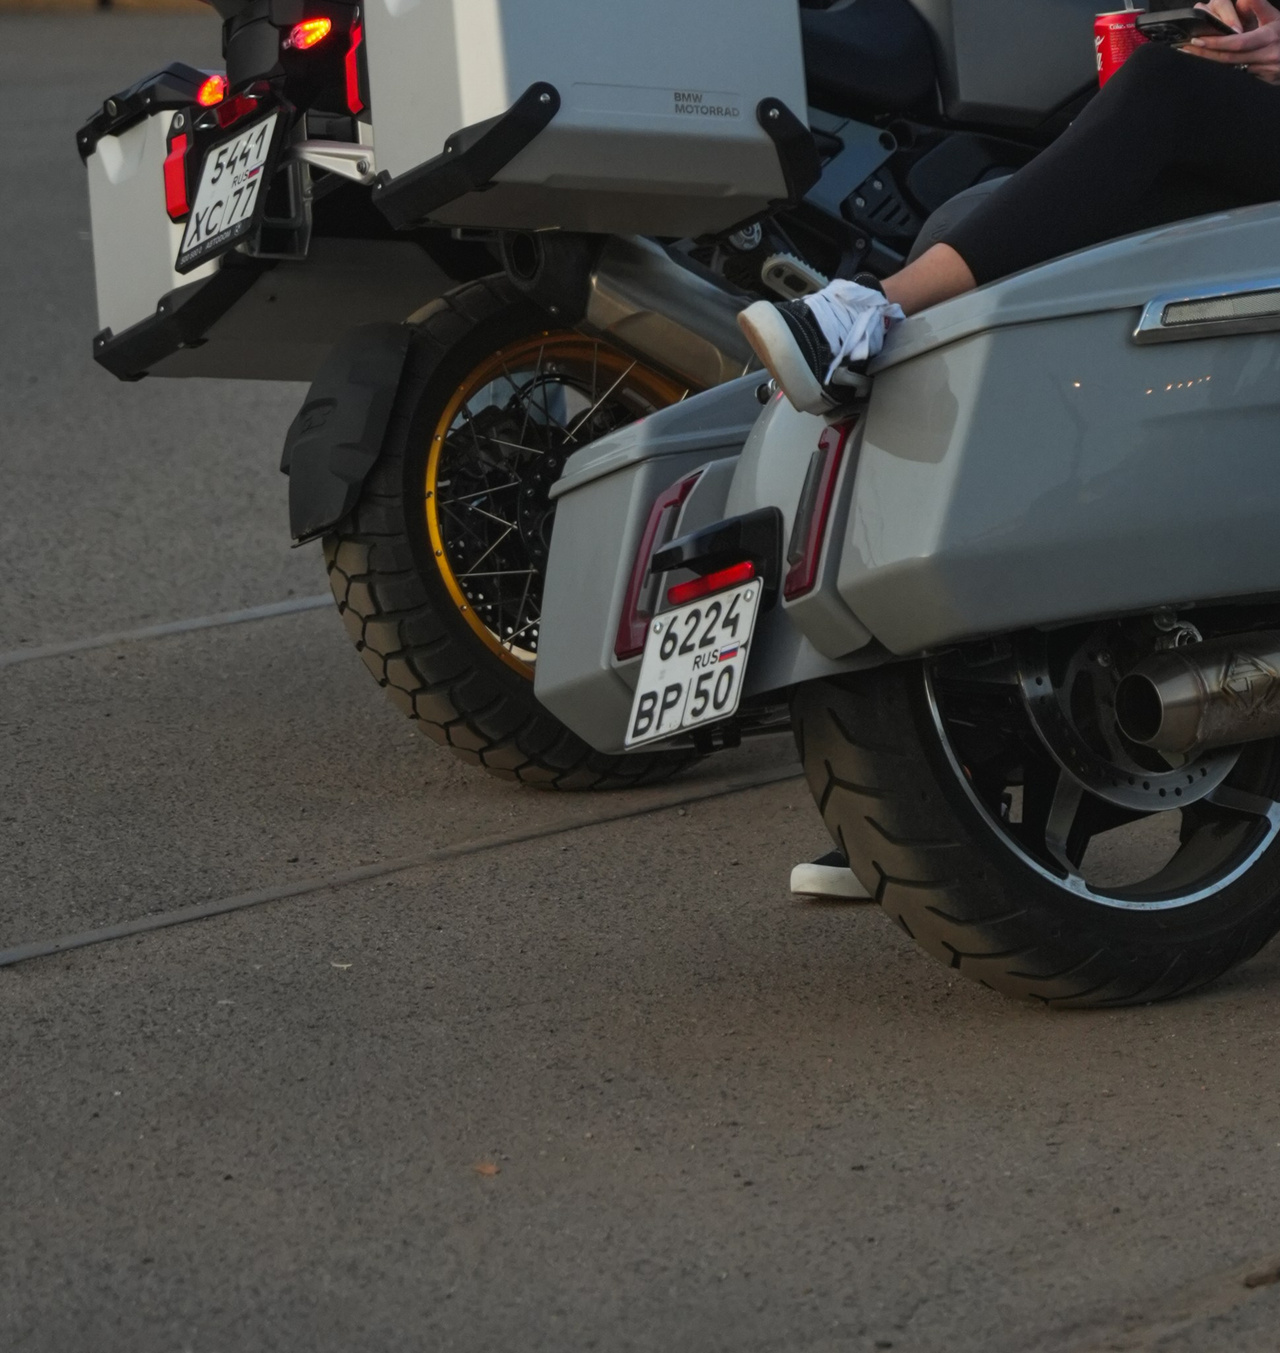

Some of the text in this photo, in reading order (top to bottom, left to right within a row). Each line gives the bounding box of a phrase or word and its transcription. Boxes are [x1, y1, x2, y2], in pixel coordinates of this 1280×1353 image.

[674, 91, 703, 103] BMW
[674, 103, 740, 117] MOTORRAD
[211, 124, 268, 185] 5441
[232, 169, 250, 189] RUS
[227, 178, 258, 225] 77
[659, 593, 741, 661] 6224
[692, 649, 719, 671] RUS
[691, 664, 734, 718] 50
